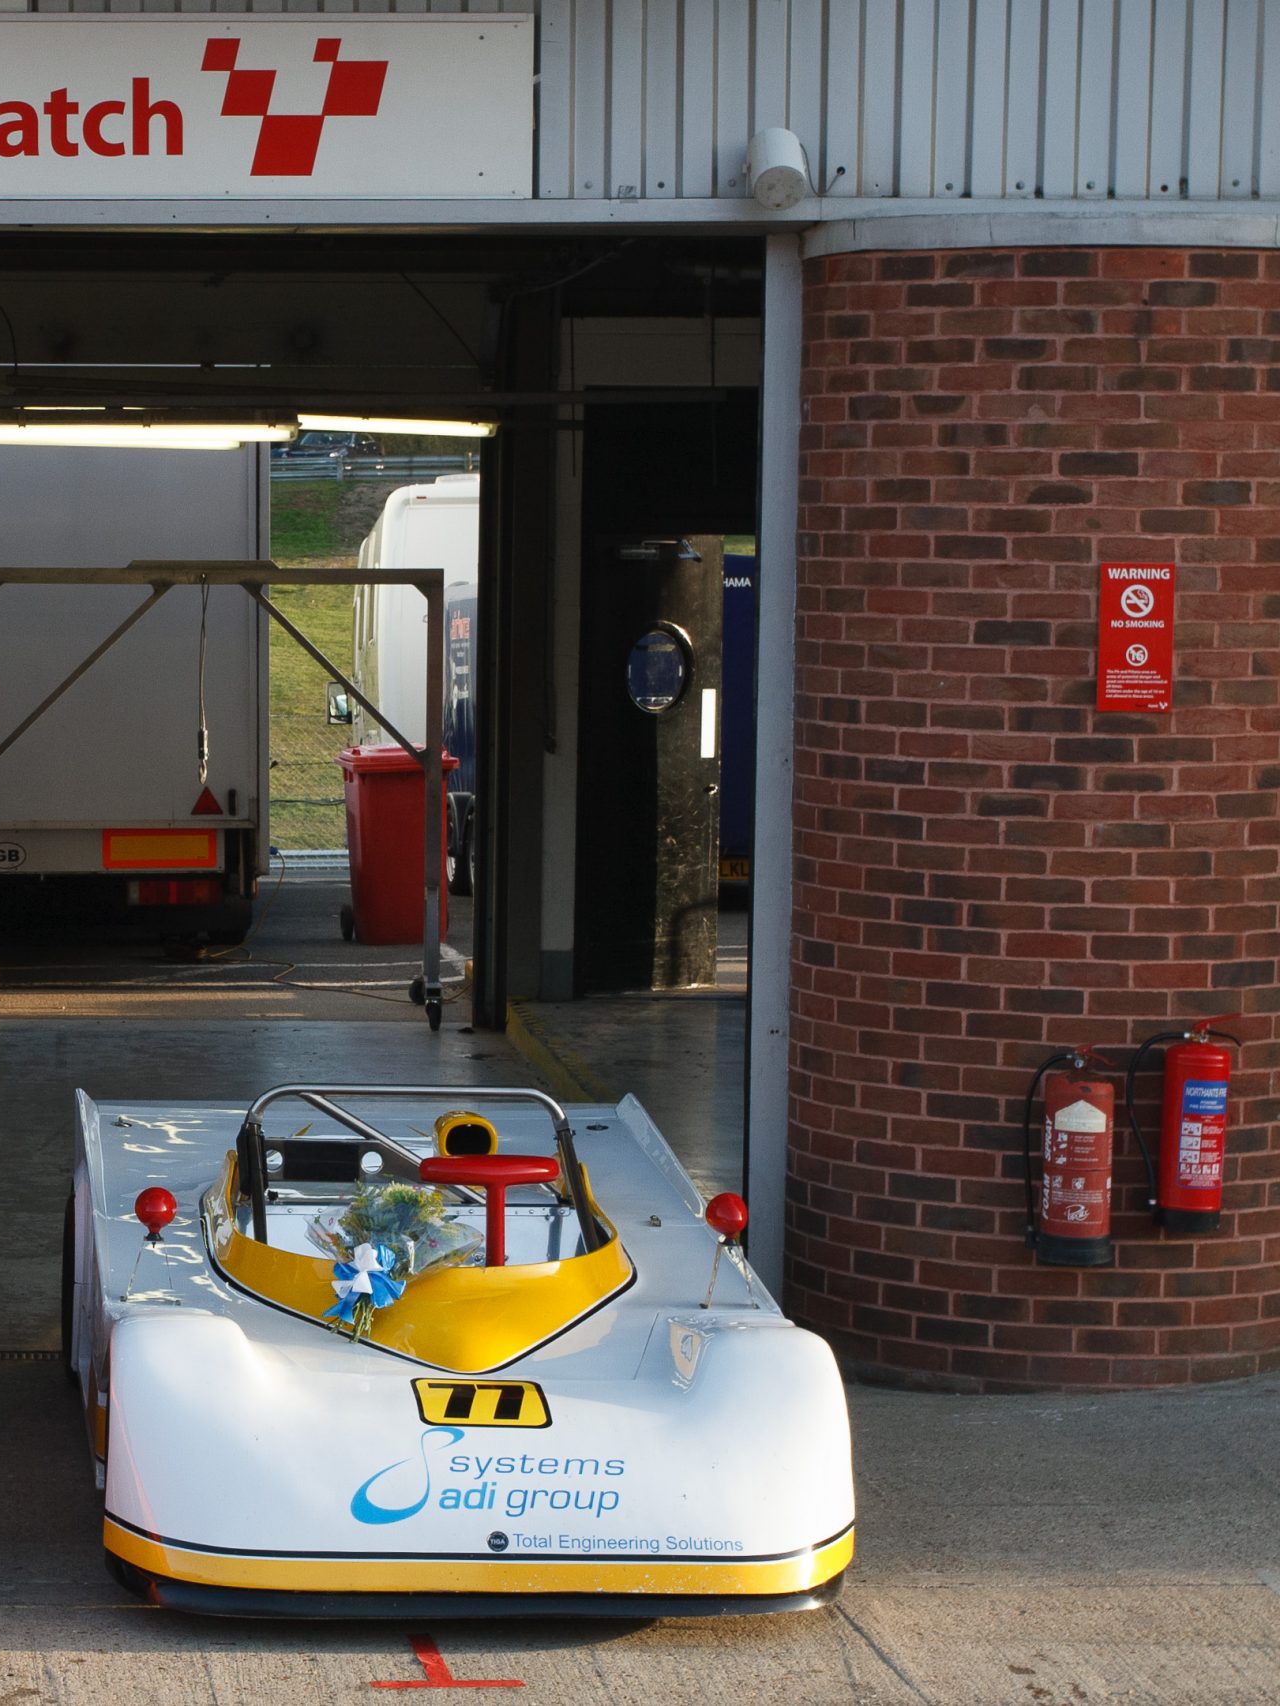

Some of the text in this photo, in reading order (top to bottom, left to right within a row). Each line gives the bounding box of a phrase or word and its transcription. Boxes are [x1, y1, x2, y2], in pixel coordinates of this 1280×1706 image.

[1108, 568, 1170, 580] WARNING
[1110, 620, 1165, 628] NO SMOKING
[1042, 1114, 1053, 1220] FOAM SPRAY
[427, 1382, 525, 1420] 77
[448, 1452, 626, 1480] systems
[438, 1481, 620, 1519] adi group
[512, 1533, 744, 1553] Total Engineering Solutions
